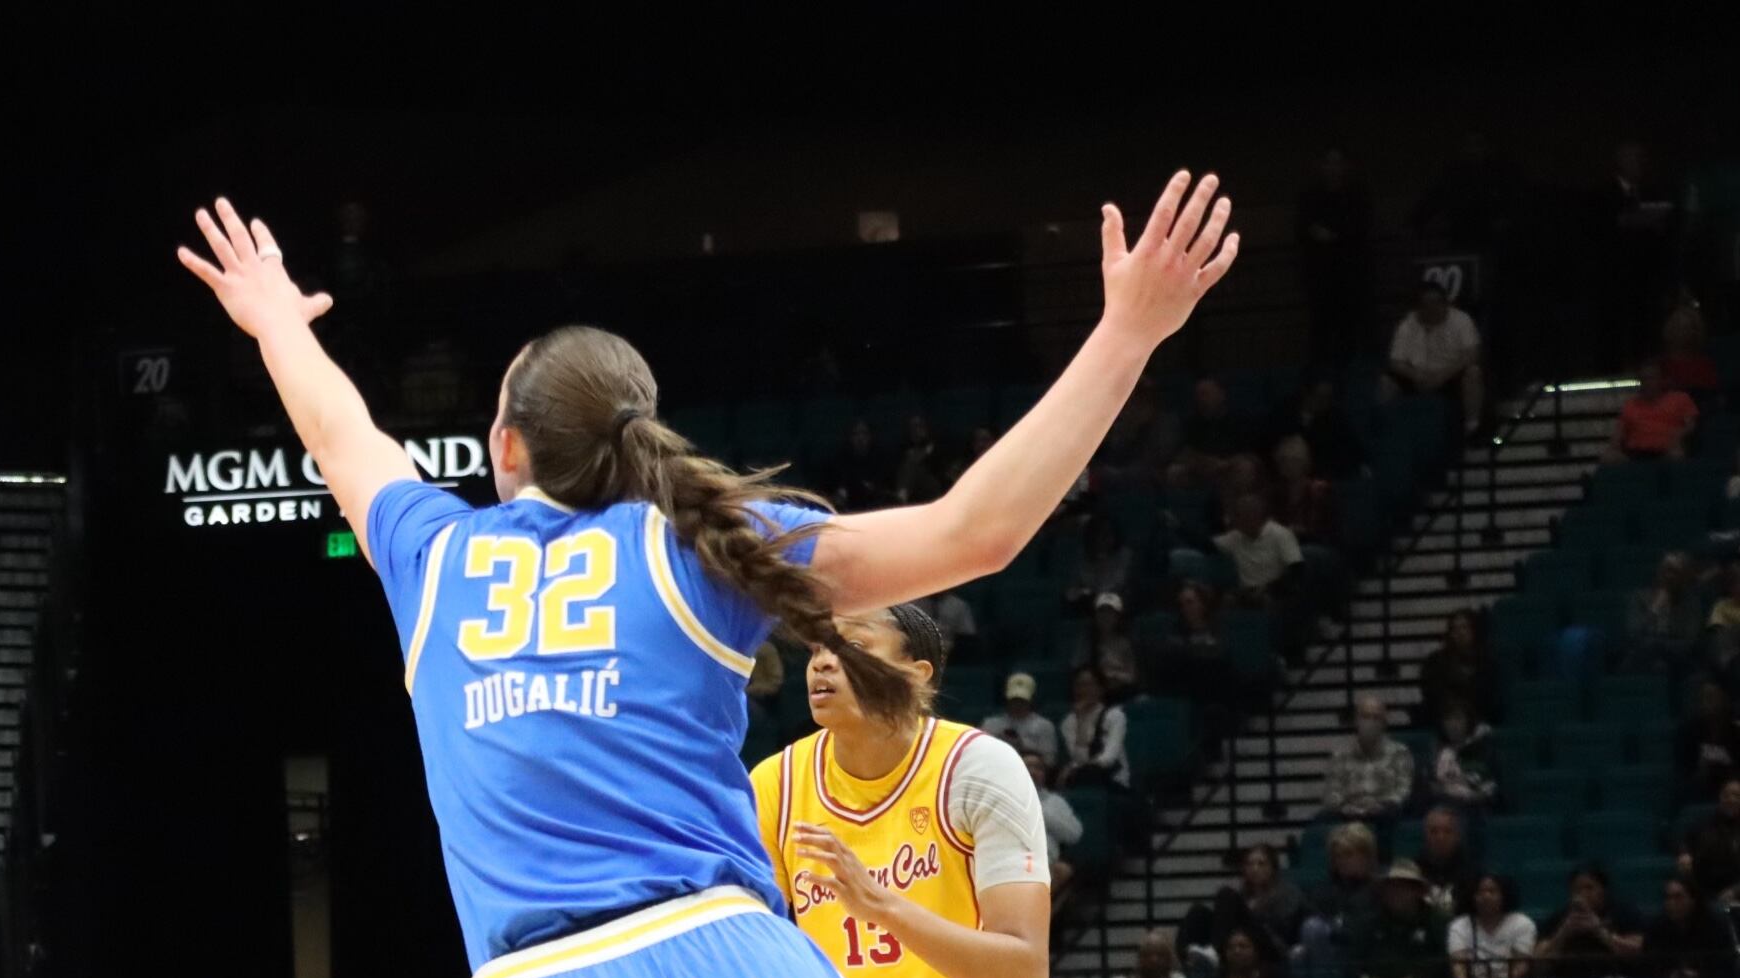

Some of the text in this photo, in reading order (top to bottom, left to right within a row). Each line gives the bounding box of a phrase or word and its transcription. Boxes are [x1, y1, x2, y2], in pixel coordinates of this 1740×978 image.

[133, 357, 171, 394] 20
[164, 449, 291, 494] MGM
[183, 501, 322, 527] GARDEN
[457, 527, 617, 661] 32
[463, 658, 620, 731] DUGALIĆ
[891, 842, 941, 891] Cal
[843, 915, 903, 967] 13
